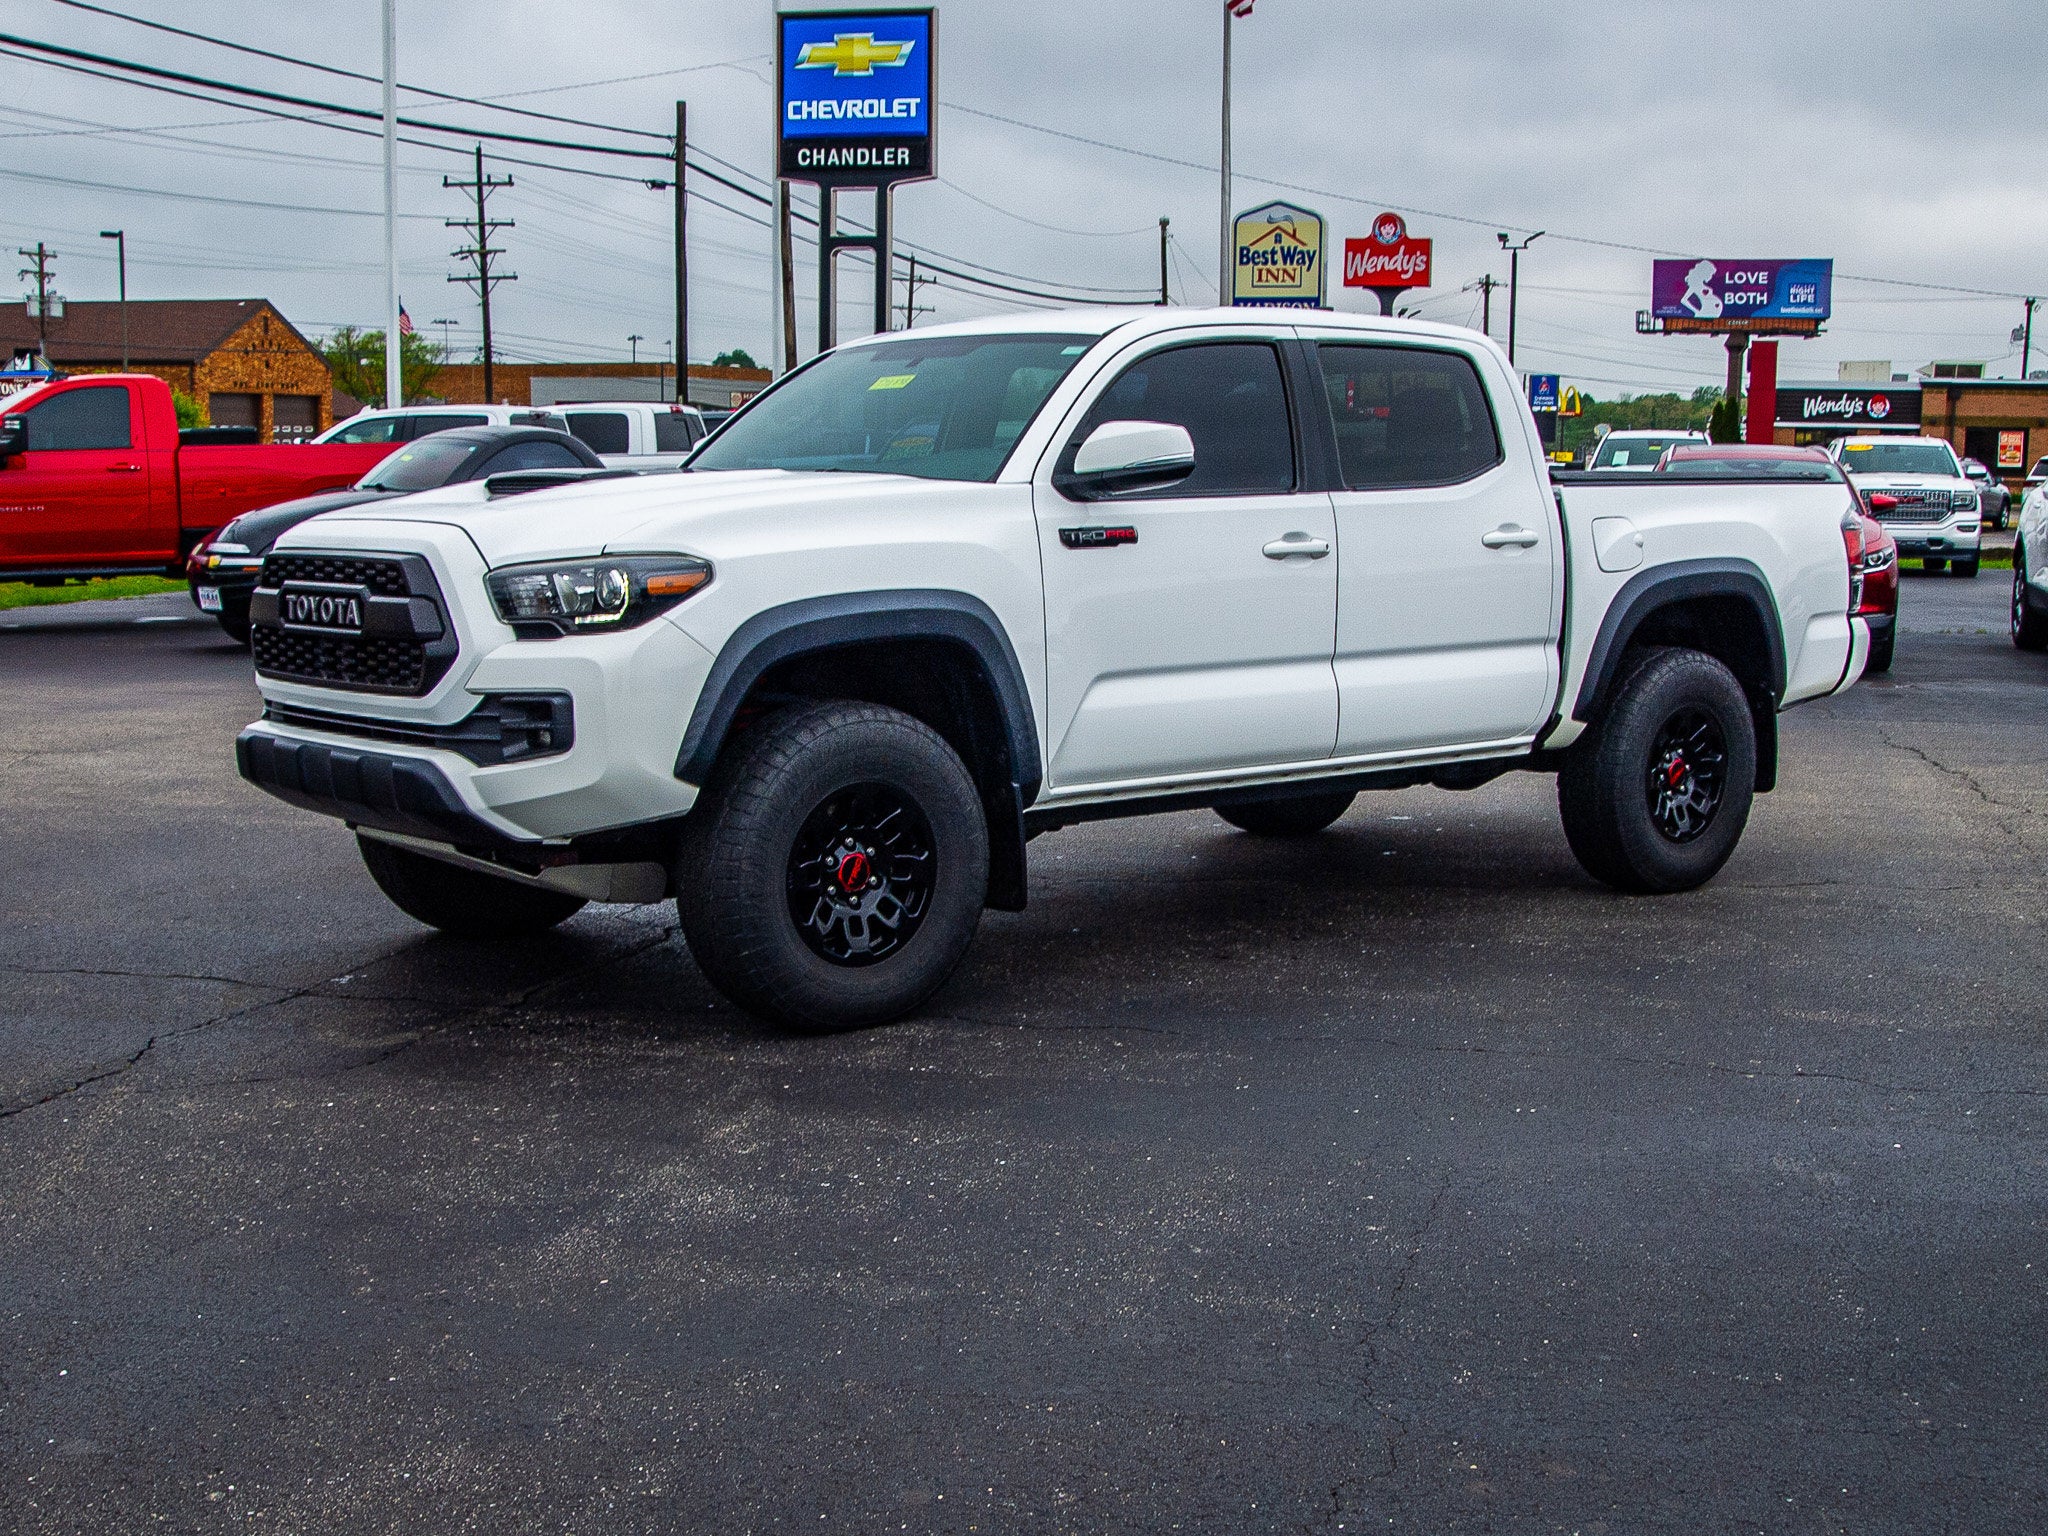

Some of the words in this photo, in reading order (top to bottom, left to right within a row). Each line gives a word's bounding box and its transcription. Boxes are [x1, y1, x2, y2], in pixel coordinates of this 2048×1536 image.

[787, 97, 921, 120] CHEVROLET
[797, 147, 910, 166] CHANDLER
[1238, 245, 1278, 266] Best
[1280, 246, 1317, 272] Way
[1347, 245, 1427, 279] Wendy's
[1256, 267, 1297, 284] INN
[1725, 271, 1769, 285] LOVE
[1724, 292, 1768, 305] BOTH
[1803, 393, 1864, 419] Wendy's
[1106, 528, 1135, 538] PRO
[285, 594, 361, 626] TOYOTA
